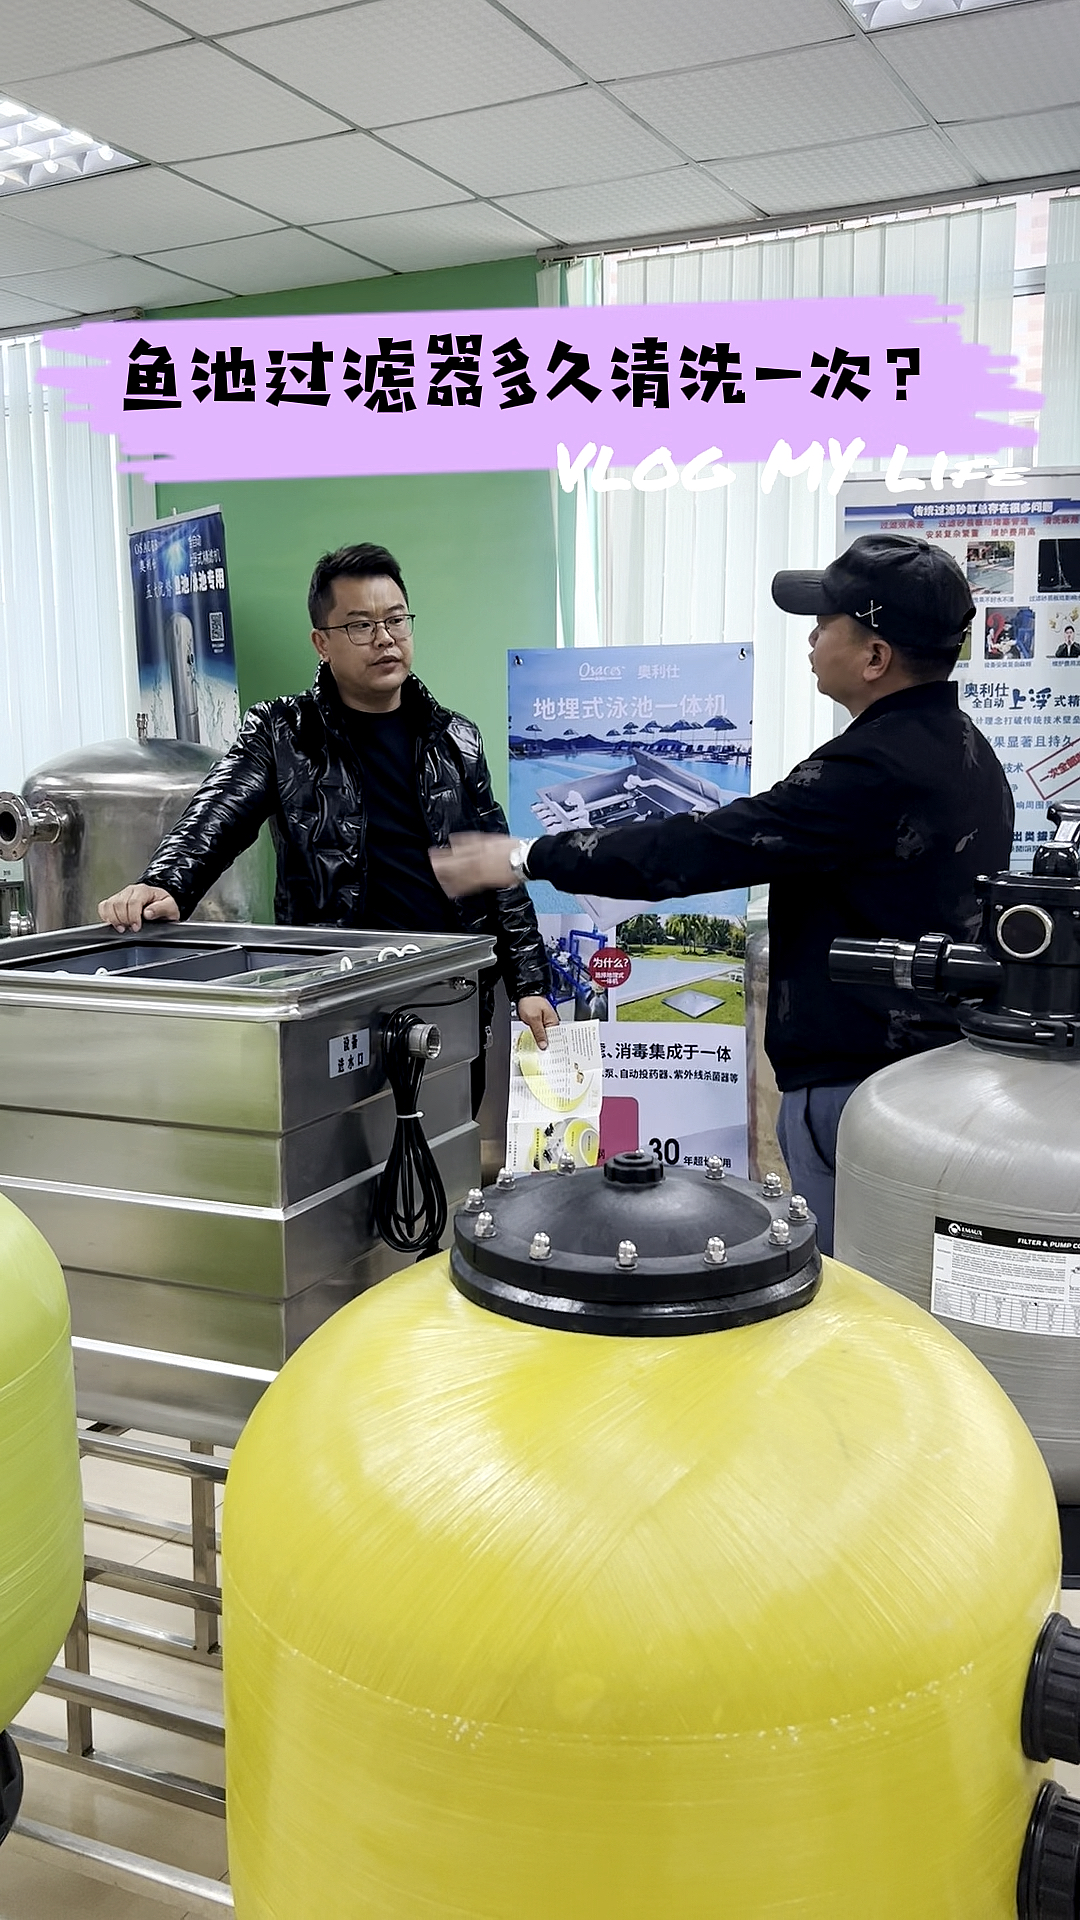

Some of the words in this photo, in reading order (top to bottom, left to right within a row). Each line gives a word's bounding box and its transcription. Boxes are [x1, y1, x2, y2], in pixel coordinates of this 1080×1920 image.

[913, 502, 1053, 517] 传统过滤砂缸总存在很多问题
[637, 664, 680, 680] 奥利仕
[963, 682, 1010, 698] 奥利仕
[533, 694, 728, 721] 地埋式泳池一体机
[593, 957, 629, 968] 为什么?
[602, 1068, 738, 1083] 泵、自动投药器、紫外线杀菌器等
[648, 1137, 680, 1166] 30
[1018, 1237, 1041, 1247] FILTER
[1050, 1241, 1072, 1249] PUMP
